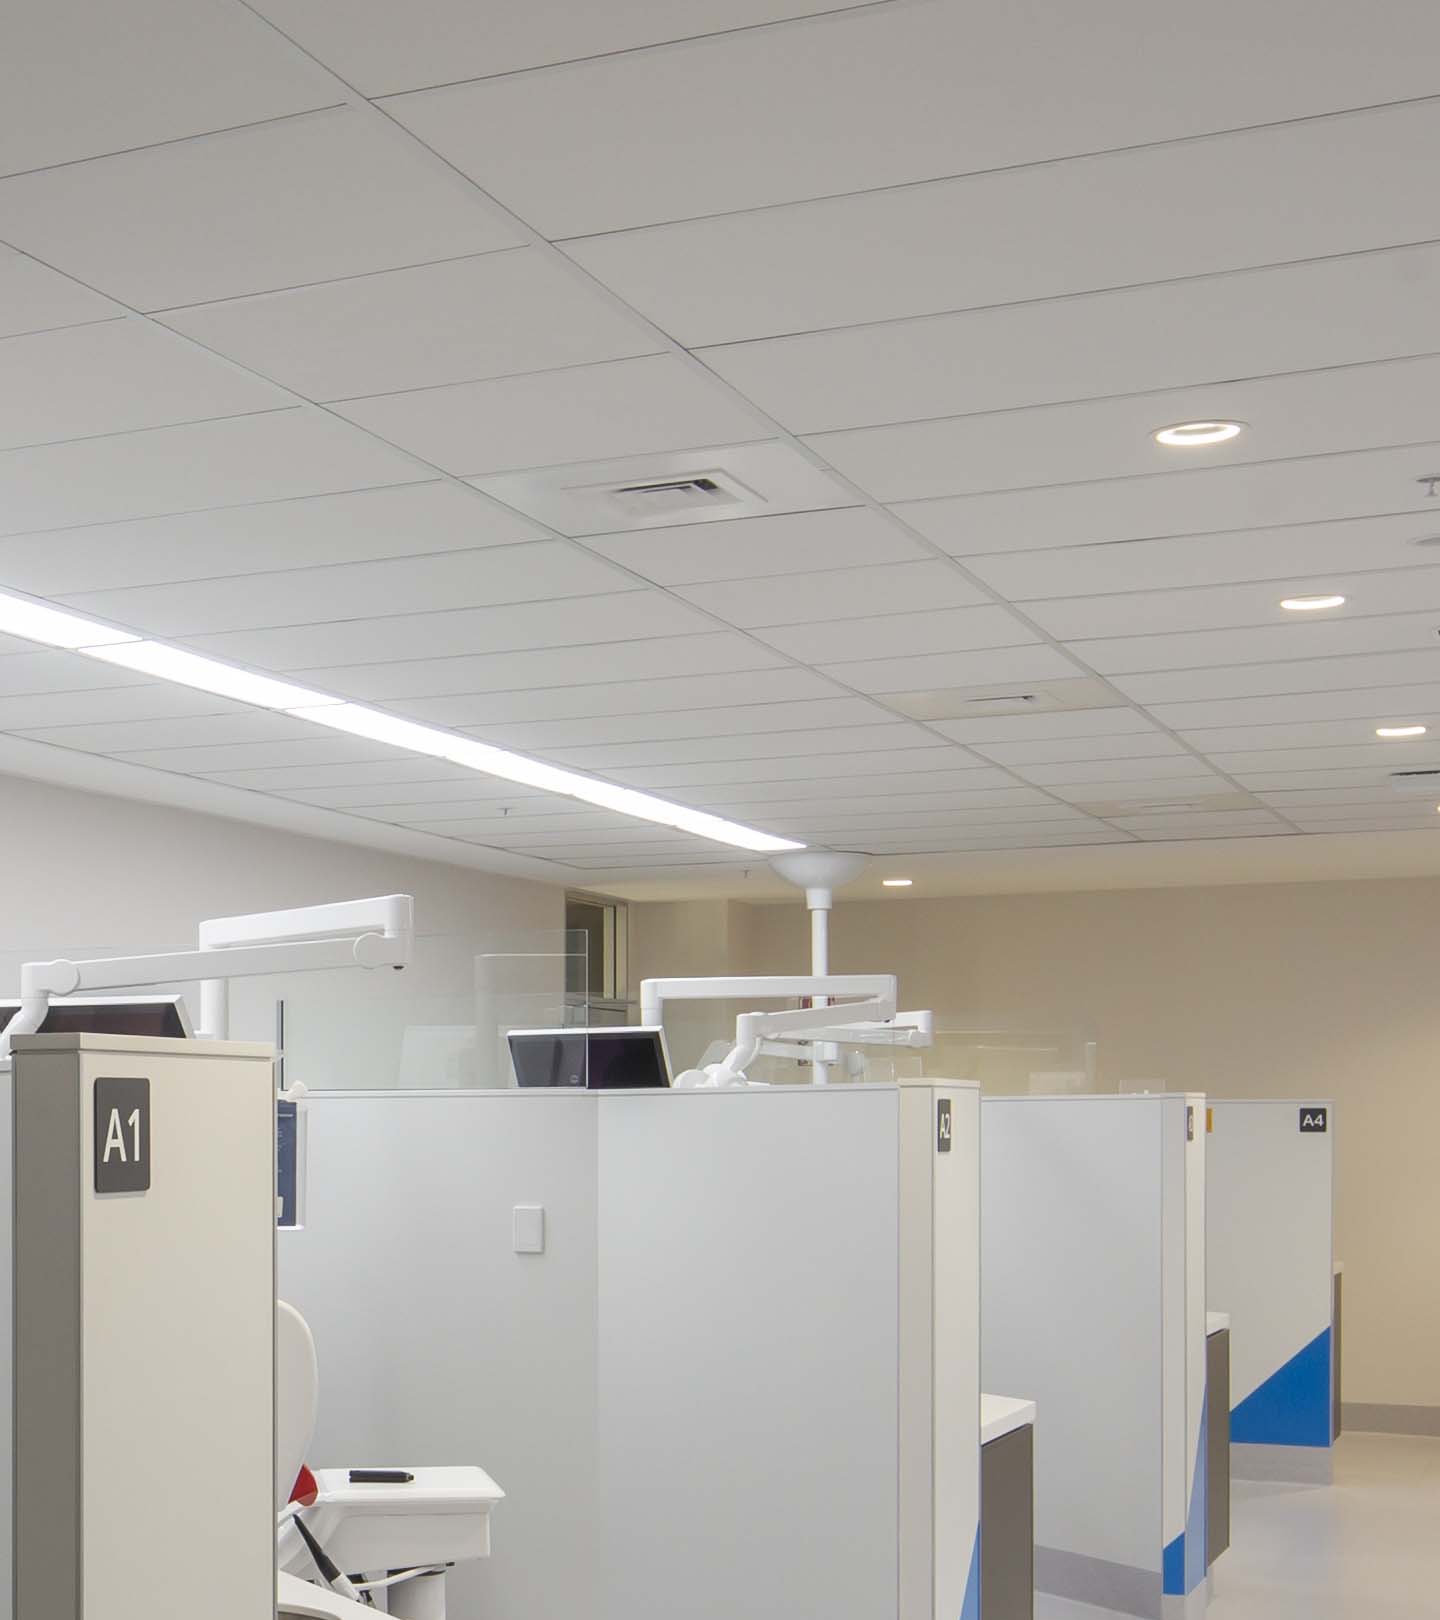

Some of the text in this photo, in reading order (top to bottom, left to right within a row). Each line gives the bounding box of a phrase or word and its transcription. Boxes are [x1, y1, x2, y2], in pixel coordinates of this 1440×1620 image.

[939, 1112, 951, 1139] A2
[1302, 1113, 1325, 1127] A4
[102, 1107, 141, 1163] A1
